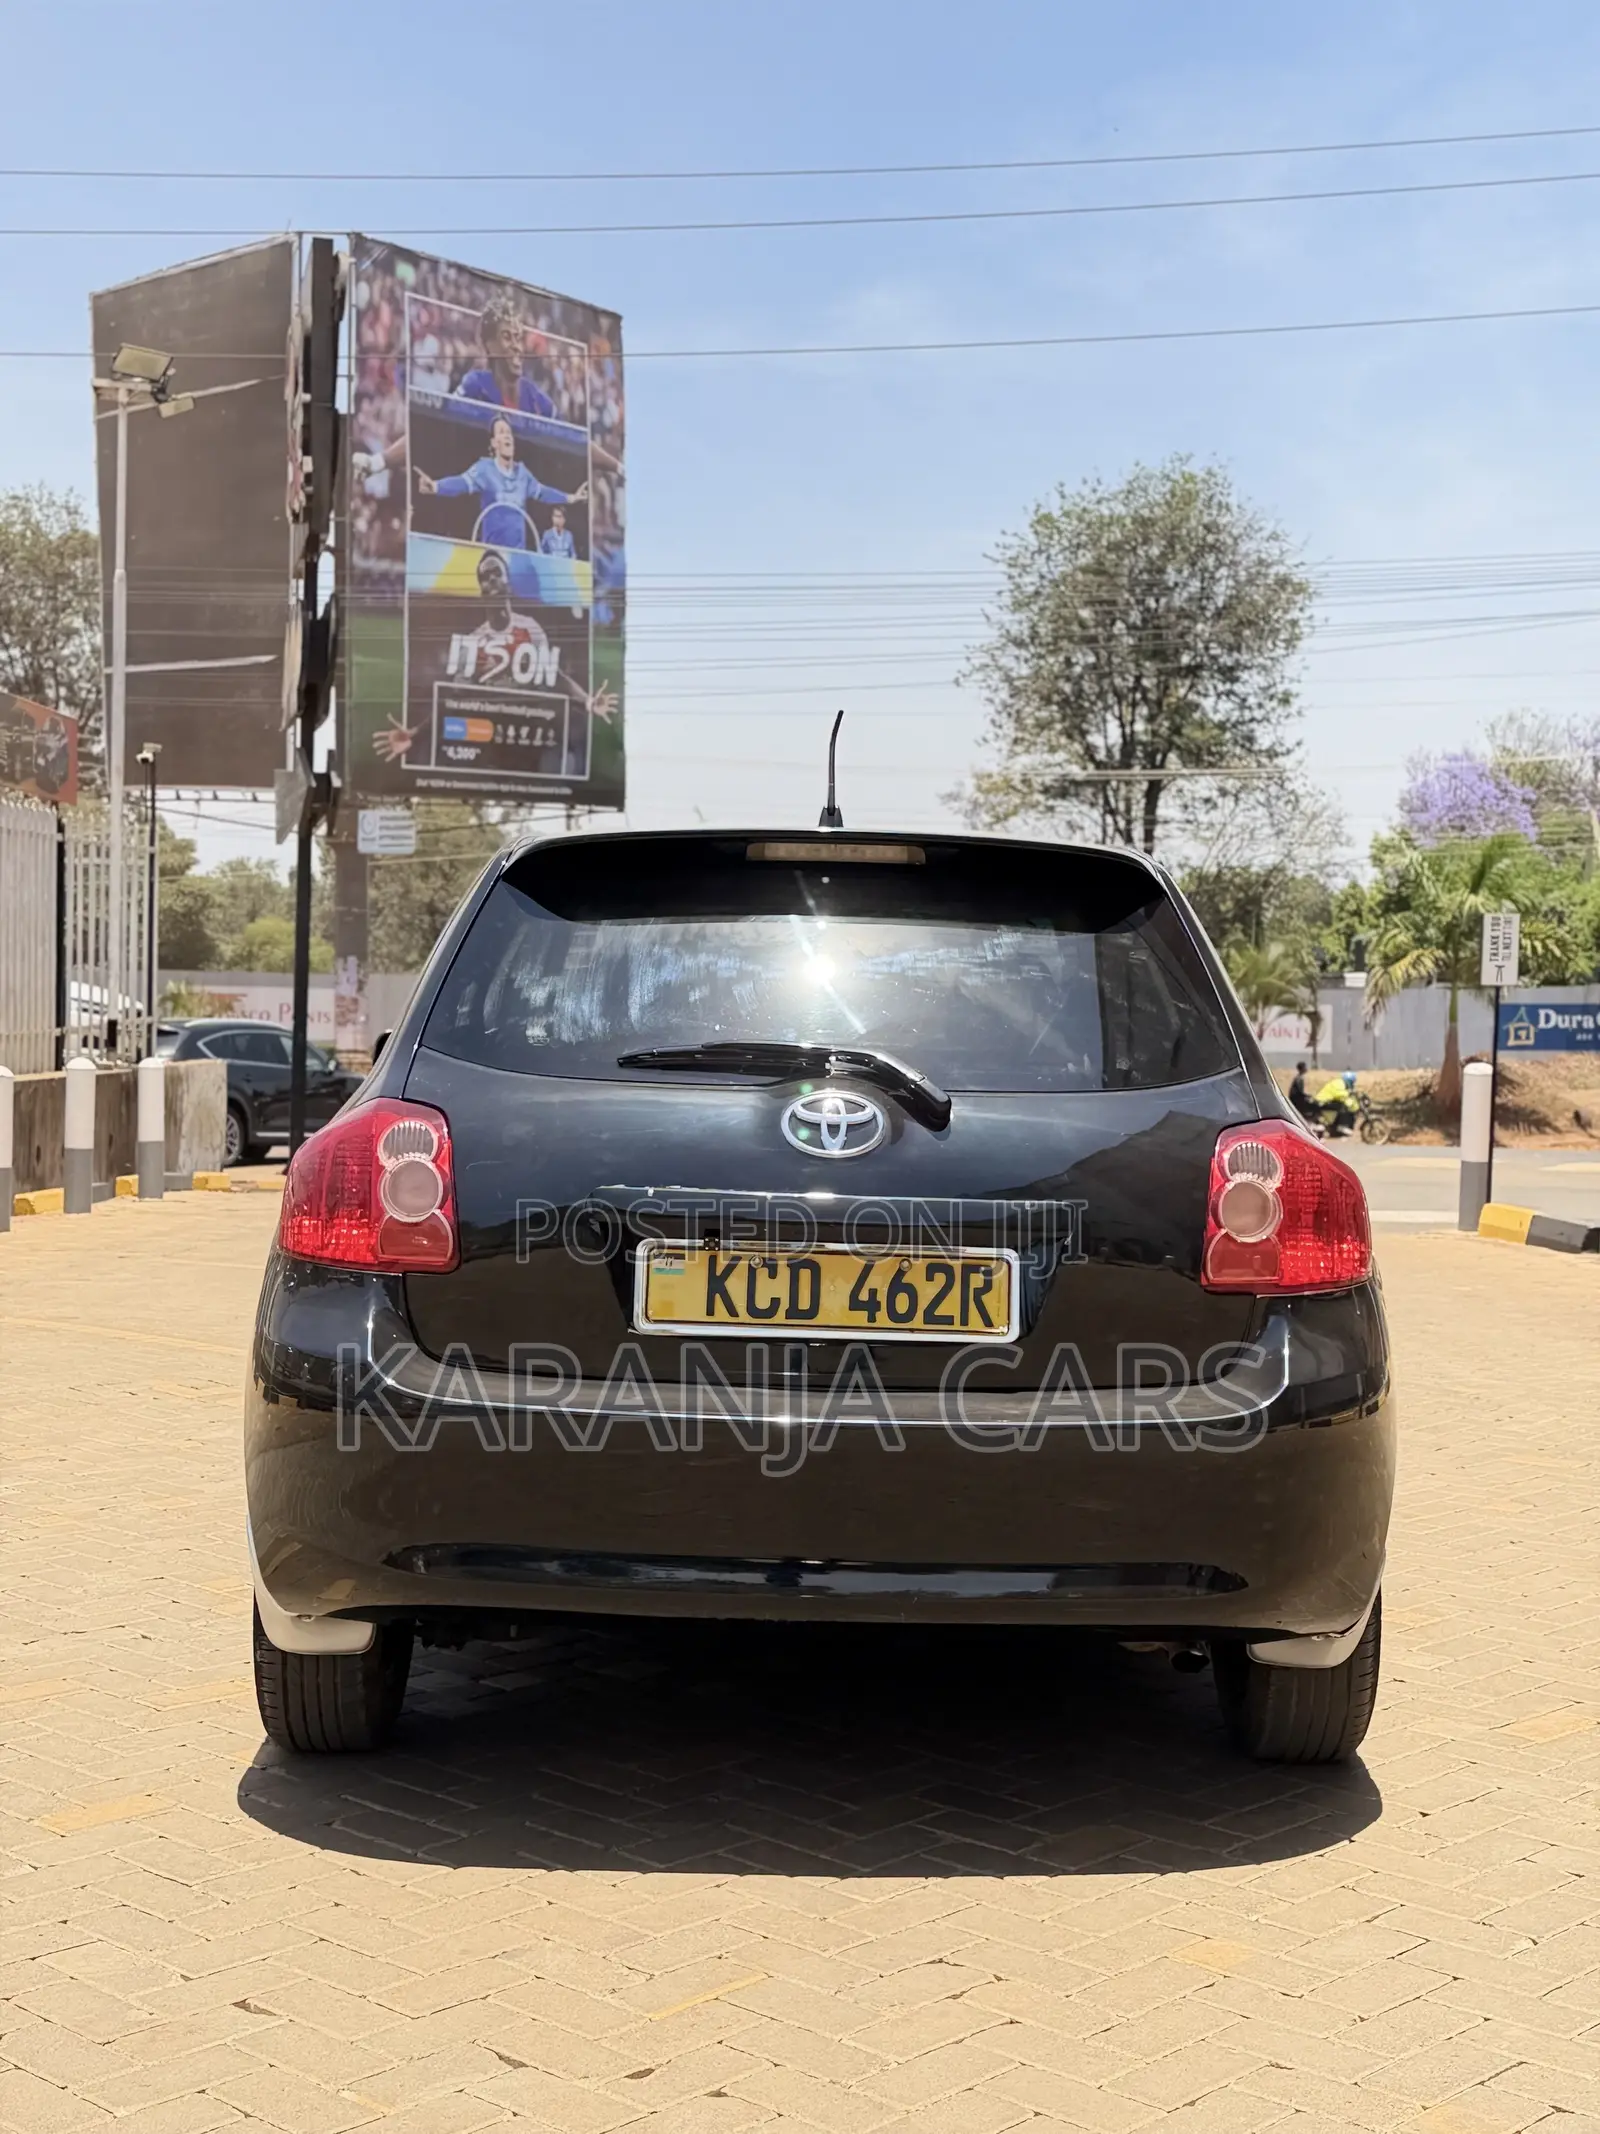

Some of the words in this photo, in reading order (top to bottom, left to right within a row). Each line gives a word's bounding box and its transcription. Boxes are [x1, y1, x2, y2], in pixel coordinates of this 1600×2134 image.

[446, 633, 514, 683] IT'S
[511, 642, 560, 687] ON
[1537, 1008, 1600, 1029] Dura
[705, 1254, 821, 1320] KCD
[849, 1260, 994, 1328] 462R
